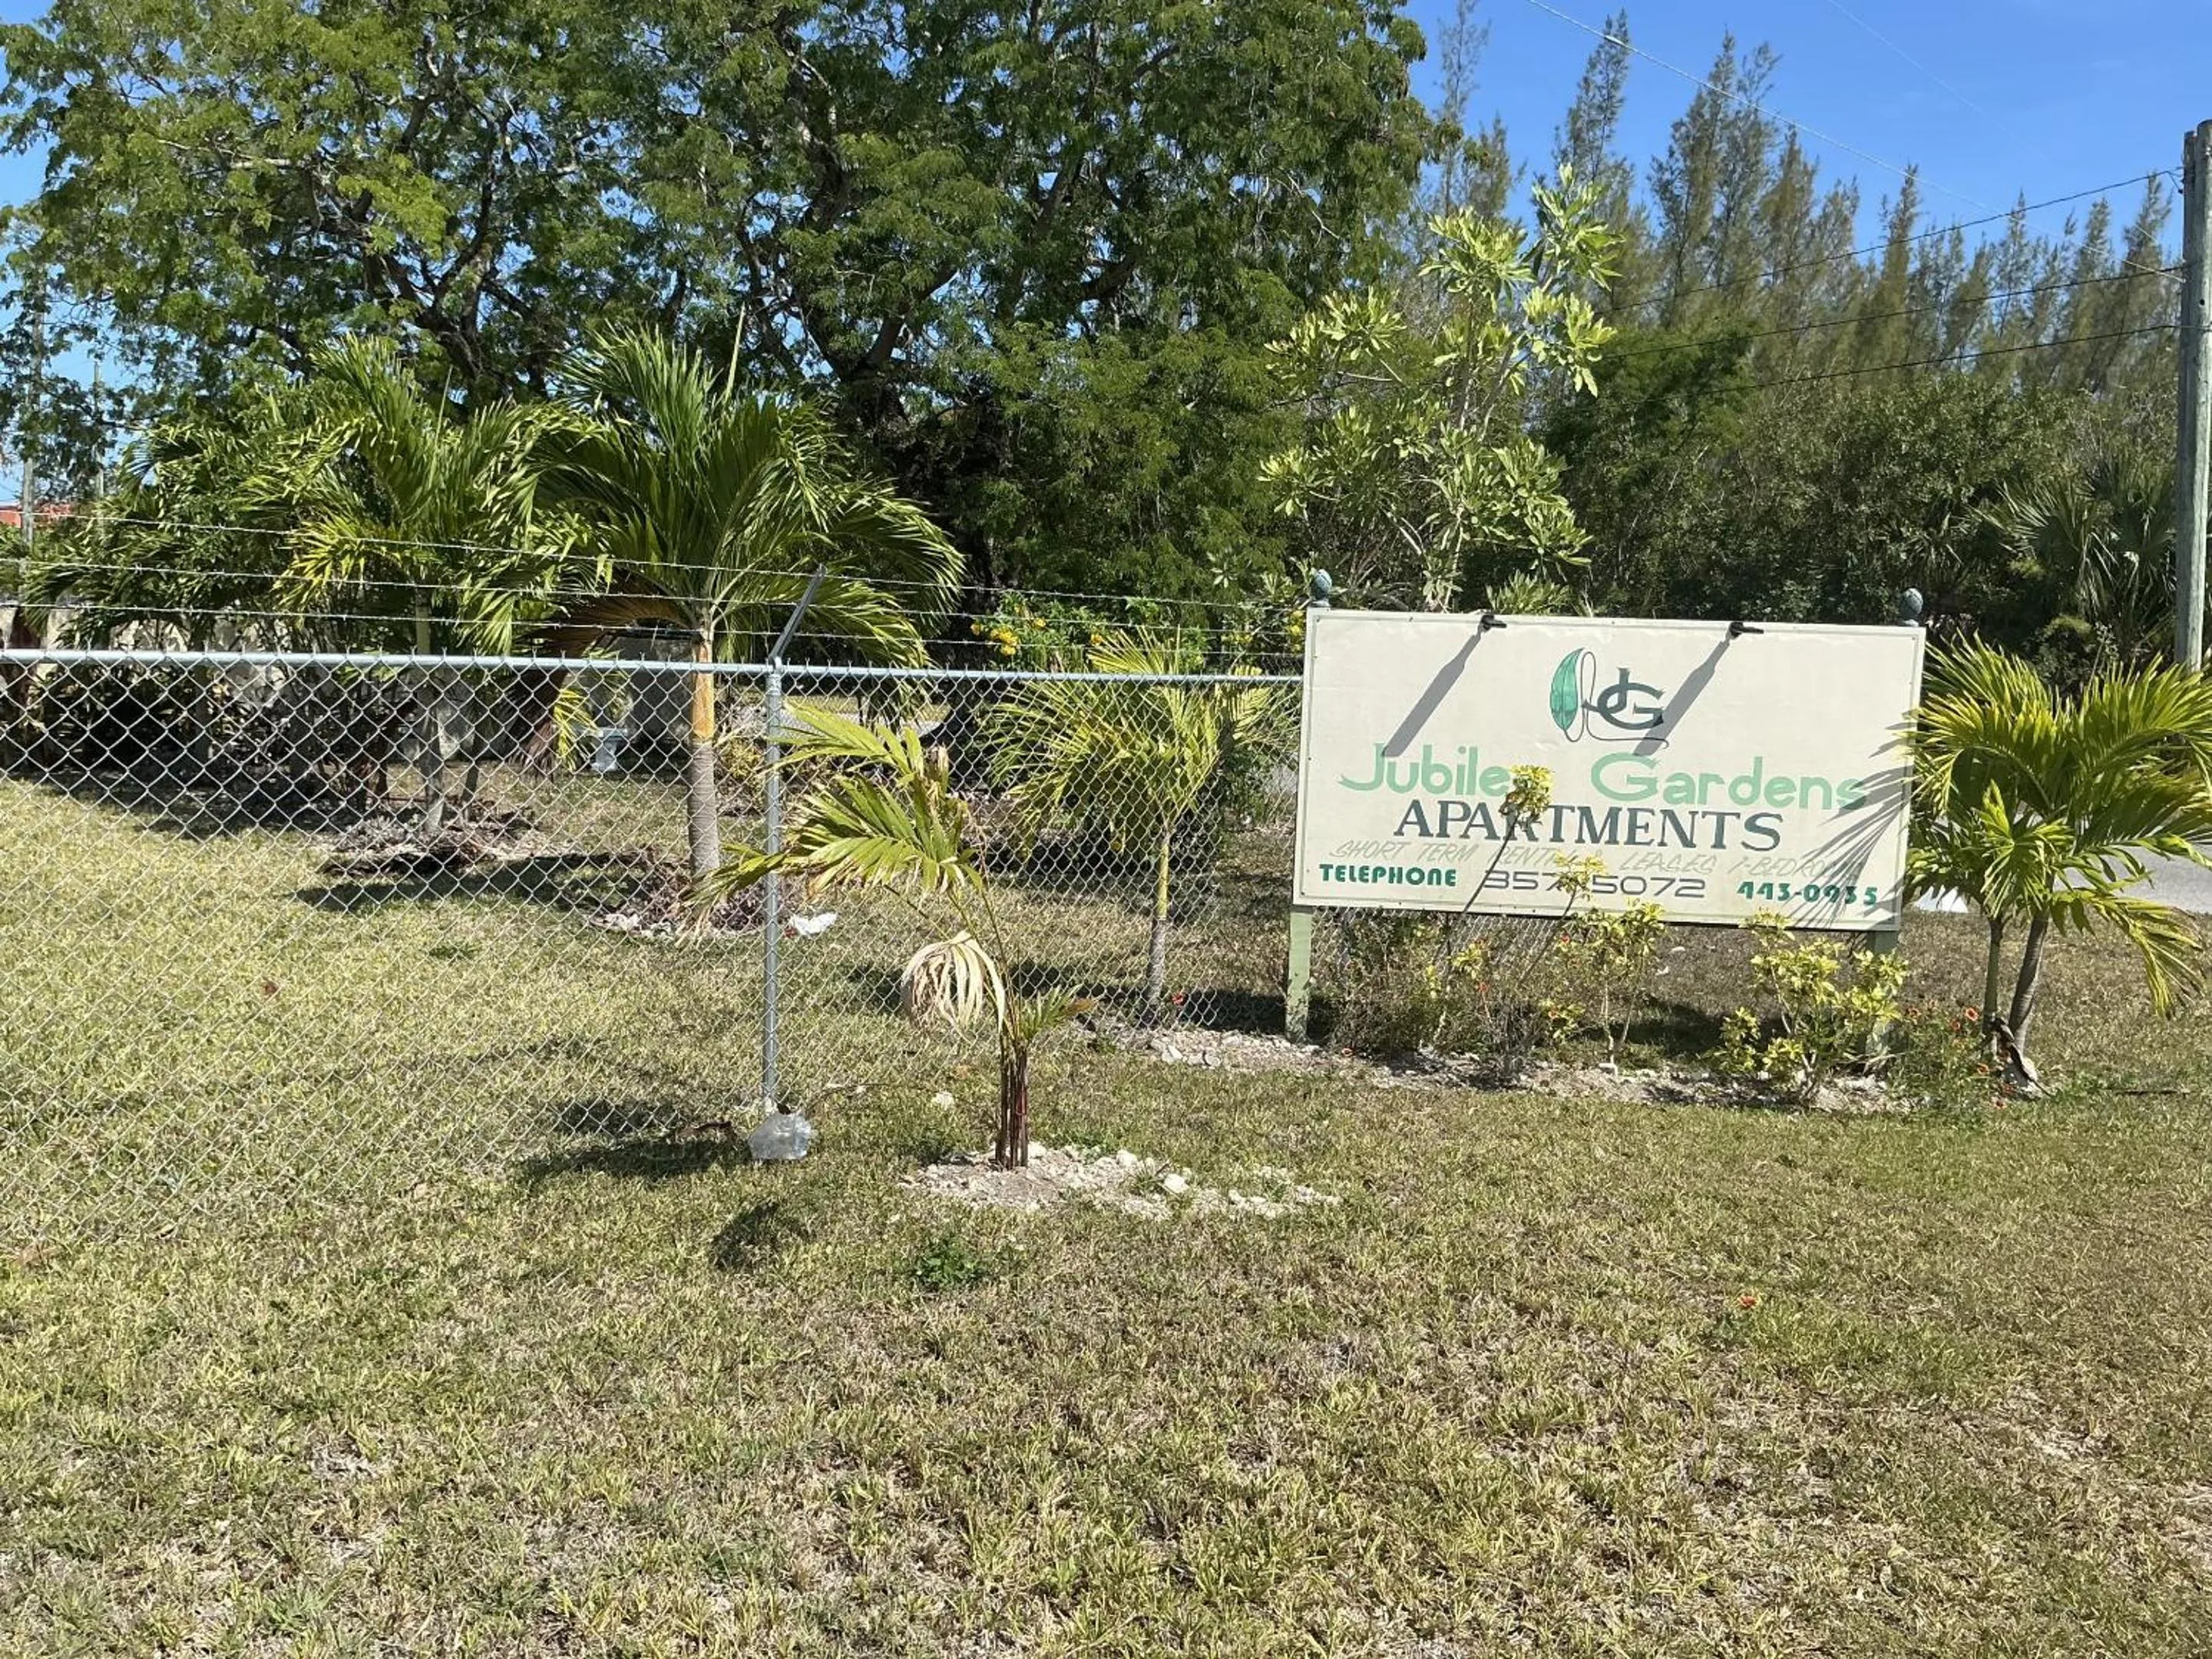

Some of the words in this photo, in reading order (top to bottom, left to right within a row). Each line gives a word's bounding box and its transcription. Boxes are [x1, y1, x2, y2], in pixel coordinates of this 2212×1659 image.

[1337, 742, 1531, 797] Jubile
[1591, 752, 1869, 811] Gardens
[1394, 799, 1784, 852] APARTMENTS
[1329, 840, 1411, 861] SHORT
[1416, 843, 1479, 862] TERM
[1319, 864, 1456, 887] TELEPHONE
[1485, 870, 1705, 898] 3575072
[1737, 881, 1878, 906] 443-0935
